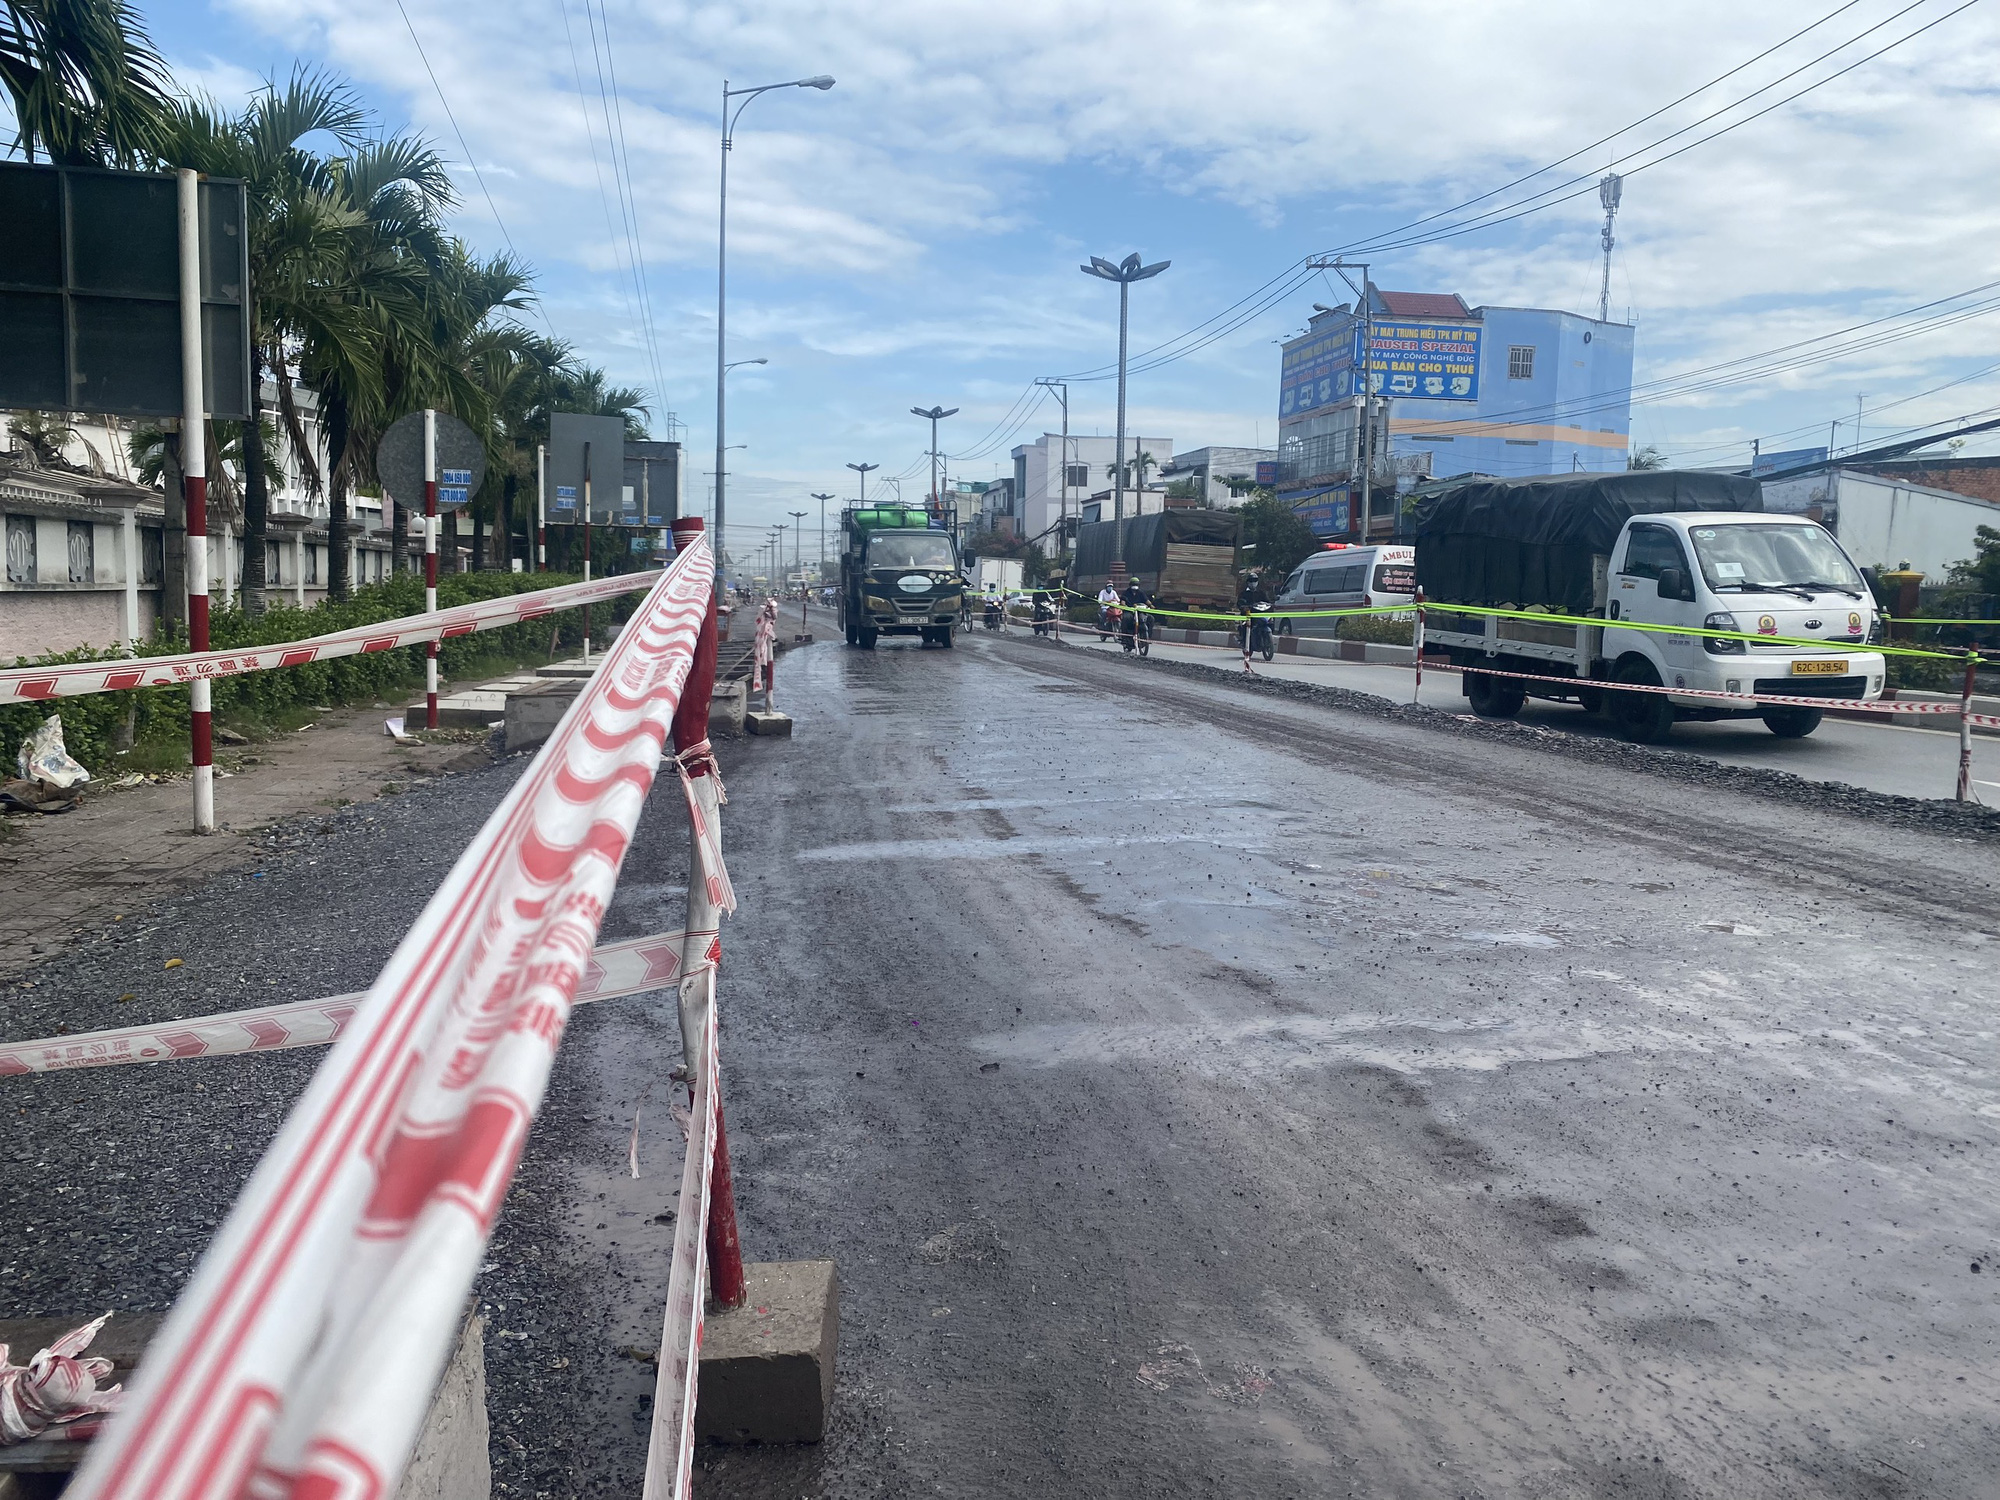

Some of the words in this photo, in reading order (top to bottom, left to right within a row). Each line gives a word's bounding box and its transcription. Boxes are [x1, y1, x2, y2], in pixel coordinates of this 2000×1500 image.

[1379, 327, 1395, 337] MAY
[1396, 328, 1419, 339] TRUNG
[1437, 330, 1451, 340] TPK
[1464, 331, 1477, 342] THO
[1421, 341, 1476, 354] SPEZIAL
[1403, 351, 1428, 361] CÔNG
[1430, 354, 1455, 363] NGHỆ
[1456, 354, 1475, 363] ĐỨC
[1391, 359, 1415, 372] BÁN
[1418, 363, 1442, 373] CHO
[1796, 662, 1844, 673] 62C-128.54
